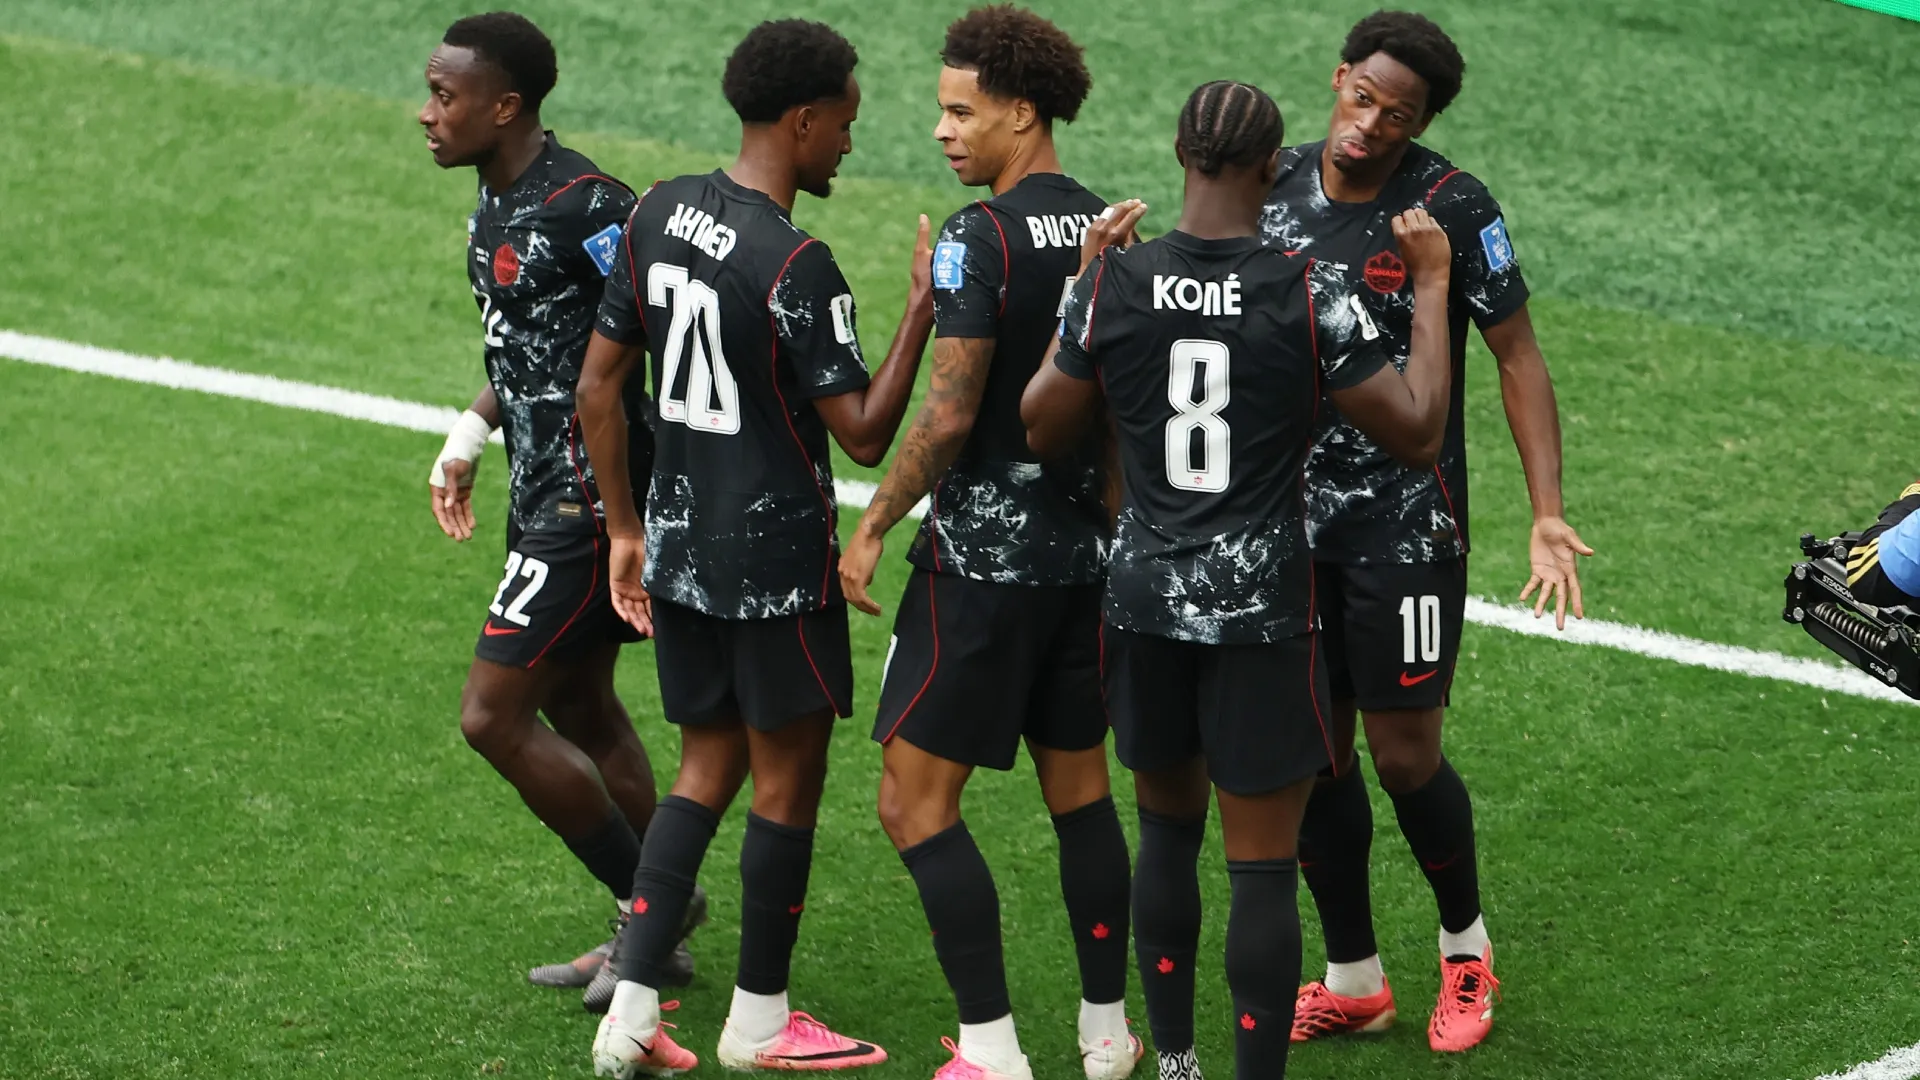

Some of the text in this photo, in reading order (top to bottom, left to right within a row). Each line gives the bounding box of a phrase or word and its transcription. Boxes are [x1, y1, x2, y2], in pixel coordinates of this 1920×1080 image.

[1366, 268, 1403, 278] CANADA
[647, 262, 741, 435] 20
[1165, 338, 1231, 493] 8
[488, 550, 549, 627] 22
[1398, 594, 1440, 663] 10
